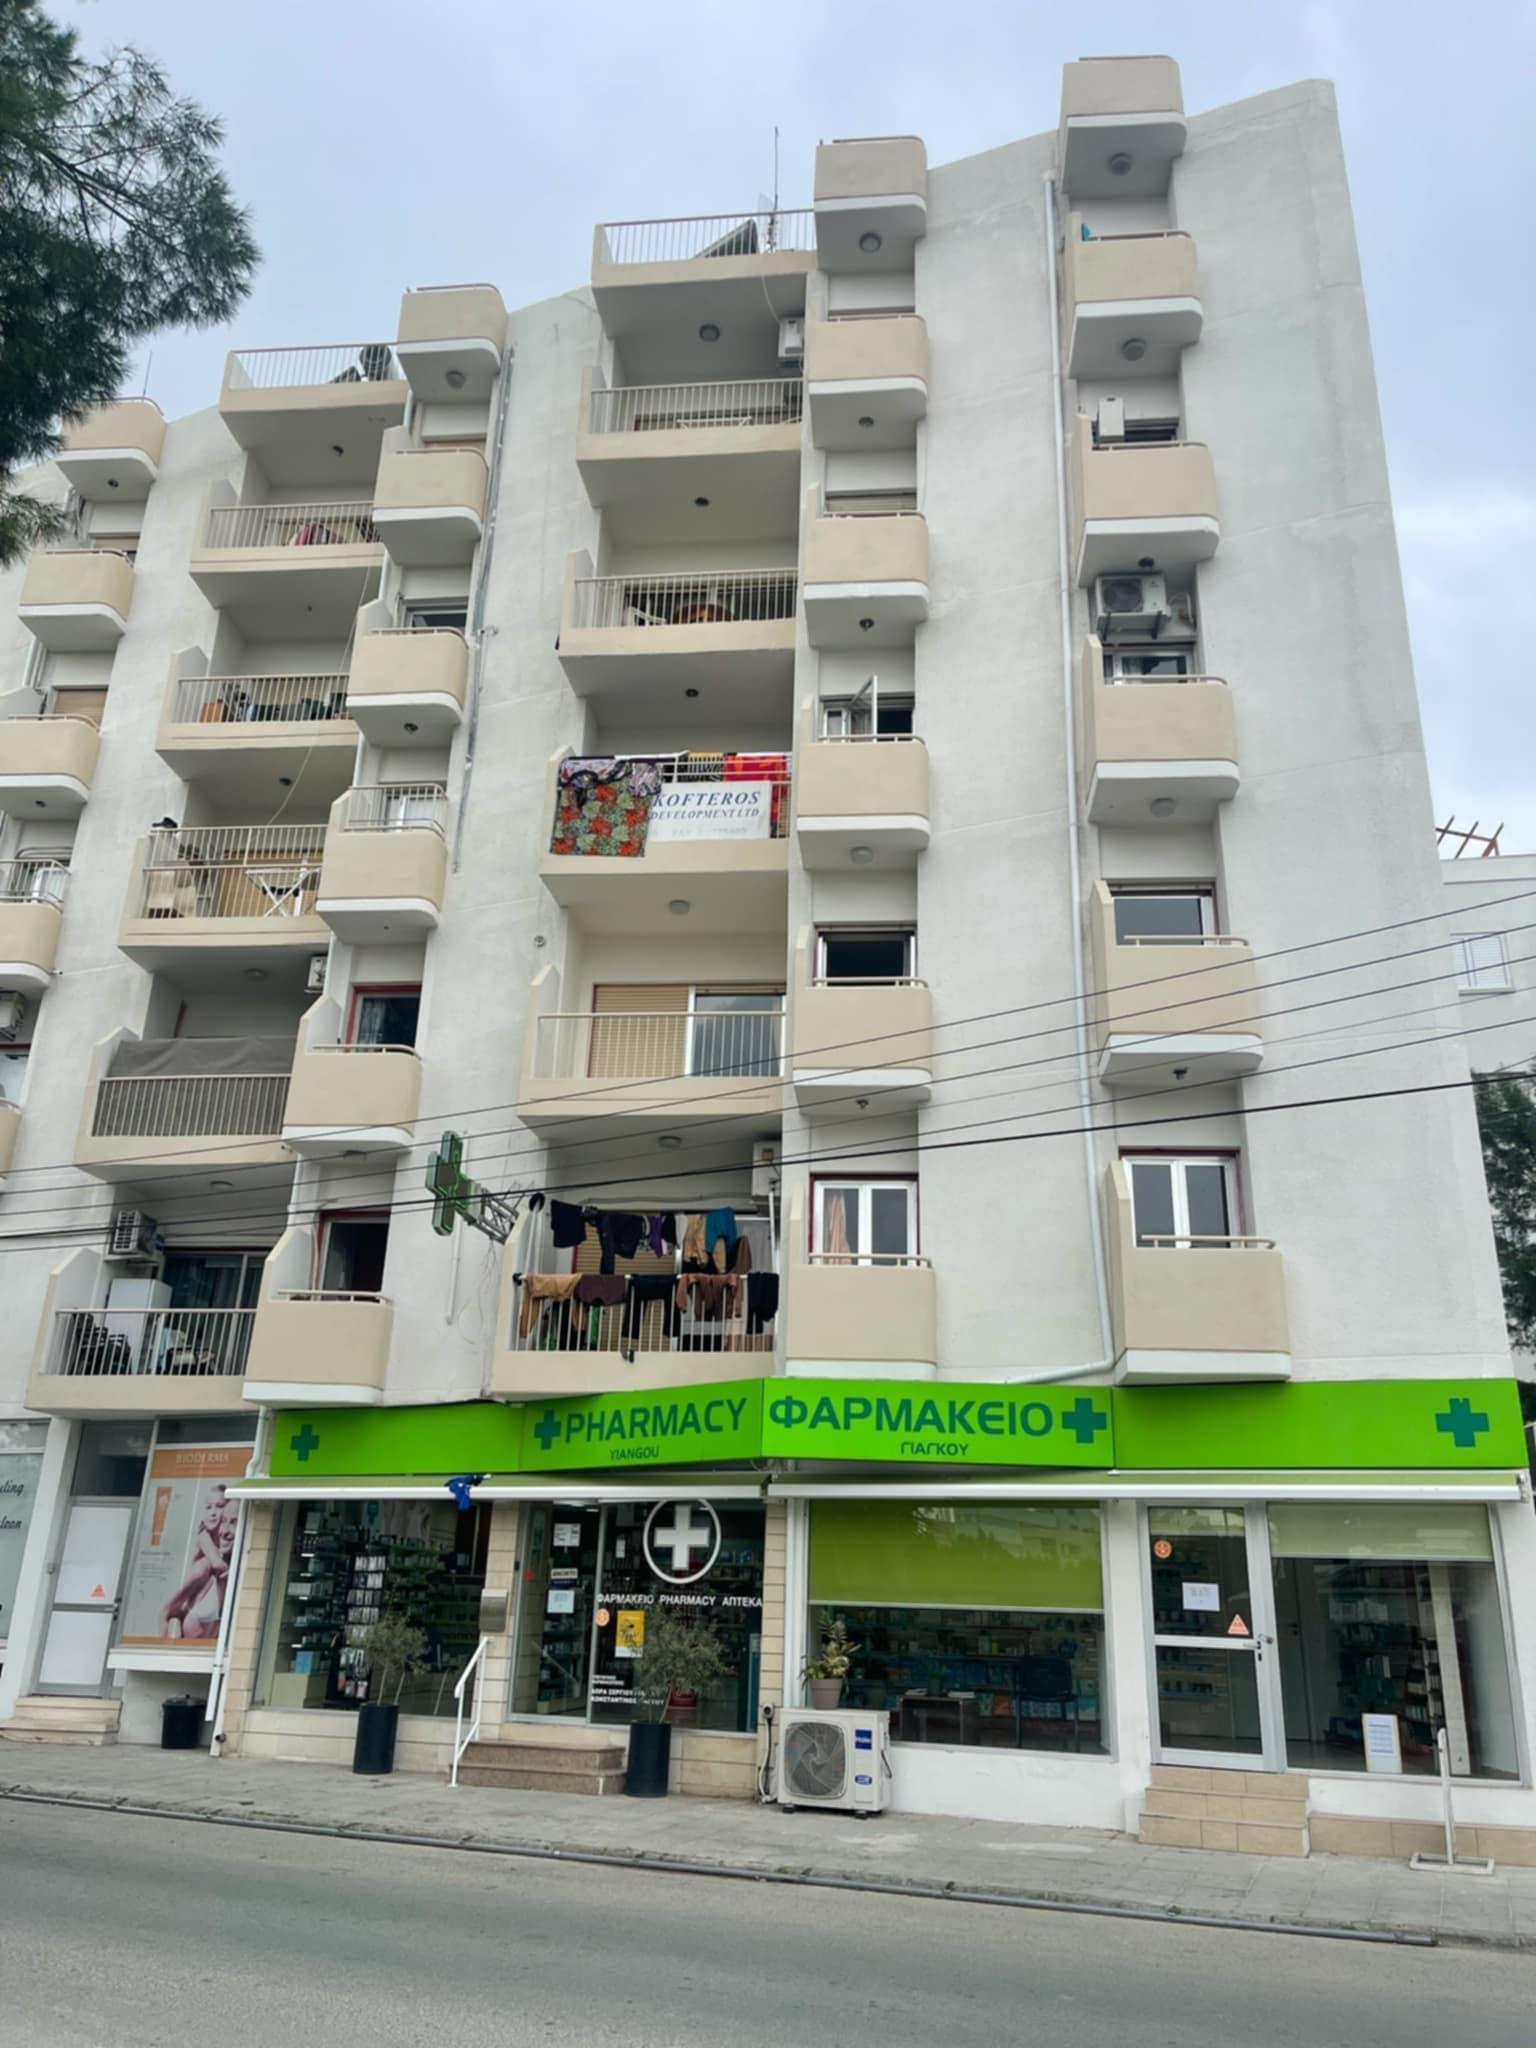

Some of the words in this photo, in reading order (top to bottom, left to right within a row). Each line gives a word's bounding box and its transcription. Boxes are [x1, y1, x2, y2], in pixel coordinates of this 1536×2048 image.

[653, 791, 760, 807] KOFTEROS
[651, 809, 735, 820] DEVELOPMENT
[737, 808, 760, 817] LTD
[566, 1398, 747, 1443] PHARMACY
[769, 1395, 1053, 1436] ΦΑΡΜΑΚΕΙΟ
[609, 1447, 660, 1461] YIANGOU
[900, 1441, 969, 1456] ΓΙΑΓΚΟΥ
[660, 1594, 716, 1606] PHARMACY
